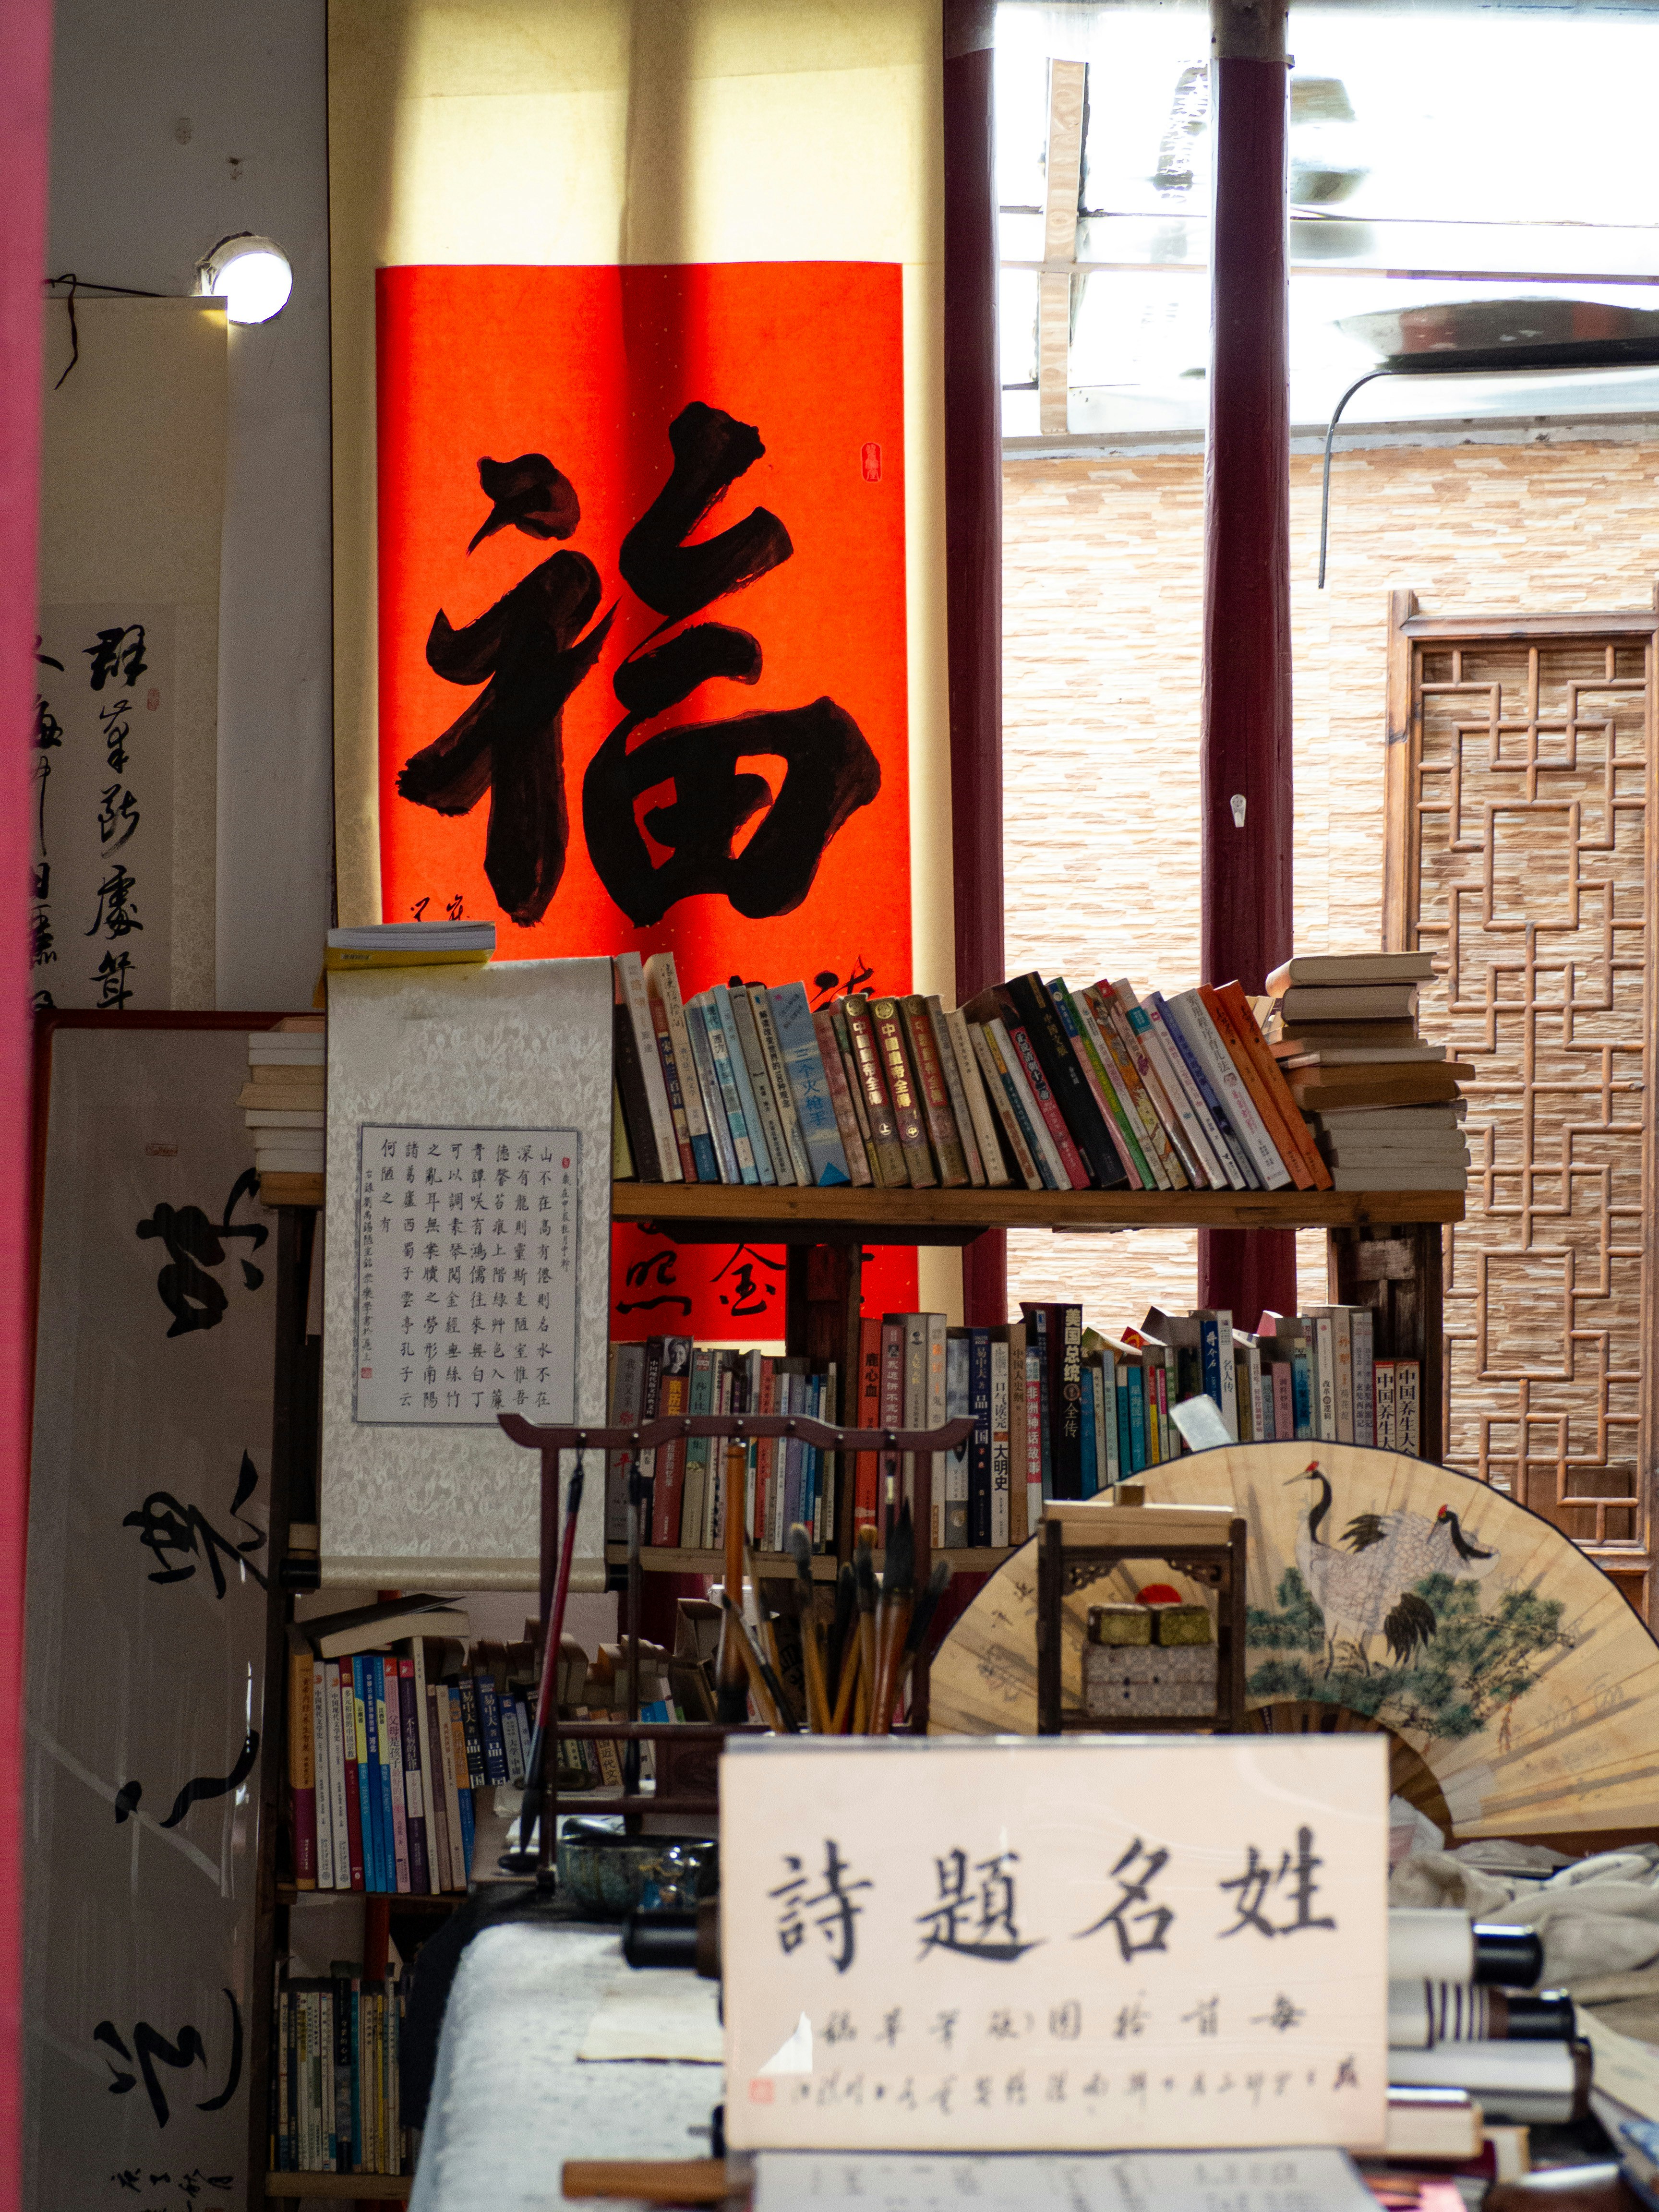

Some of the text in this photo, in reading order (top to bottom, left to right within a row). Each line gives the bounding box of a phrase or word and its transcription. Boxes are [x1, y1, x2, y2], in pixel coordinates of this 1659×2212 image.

[396, 400, 882, 928] 福
[1187, 993, 1232, 1074] 实用程序育儿法
[794, 1046, 827, 1127] 三个火枪手
[379, 1139, 397, 1233] 何陋之有
[975, 1347, 989, 1379] 易中天
[1011, 1348, 1025, 1403] 中国人史纲
[1063, 1308, 1082, 1438] 美国总统 全传
[1222, 1358, 1235, 1394] 名人传
[974, 1395, 989, 1445] 品三国
[1026, 1386, 1041, 1476] 非洲神话故事
[993, 1444, 1009, 1491] 大明史
[463, 1691, 475, 1724] 易中天
[484, 1691, 497, 1727] 易中天
[467, 1739, 486, 1789] 品三国
